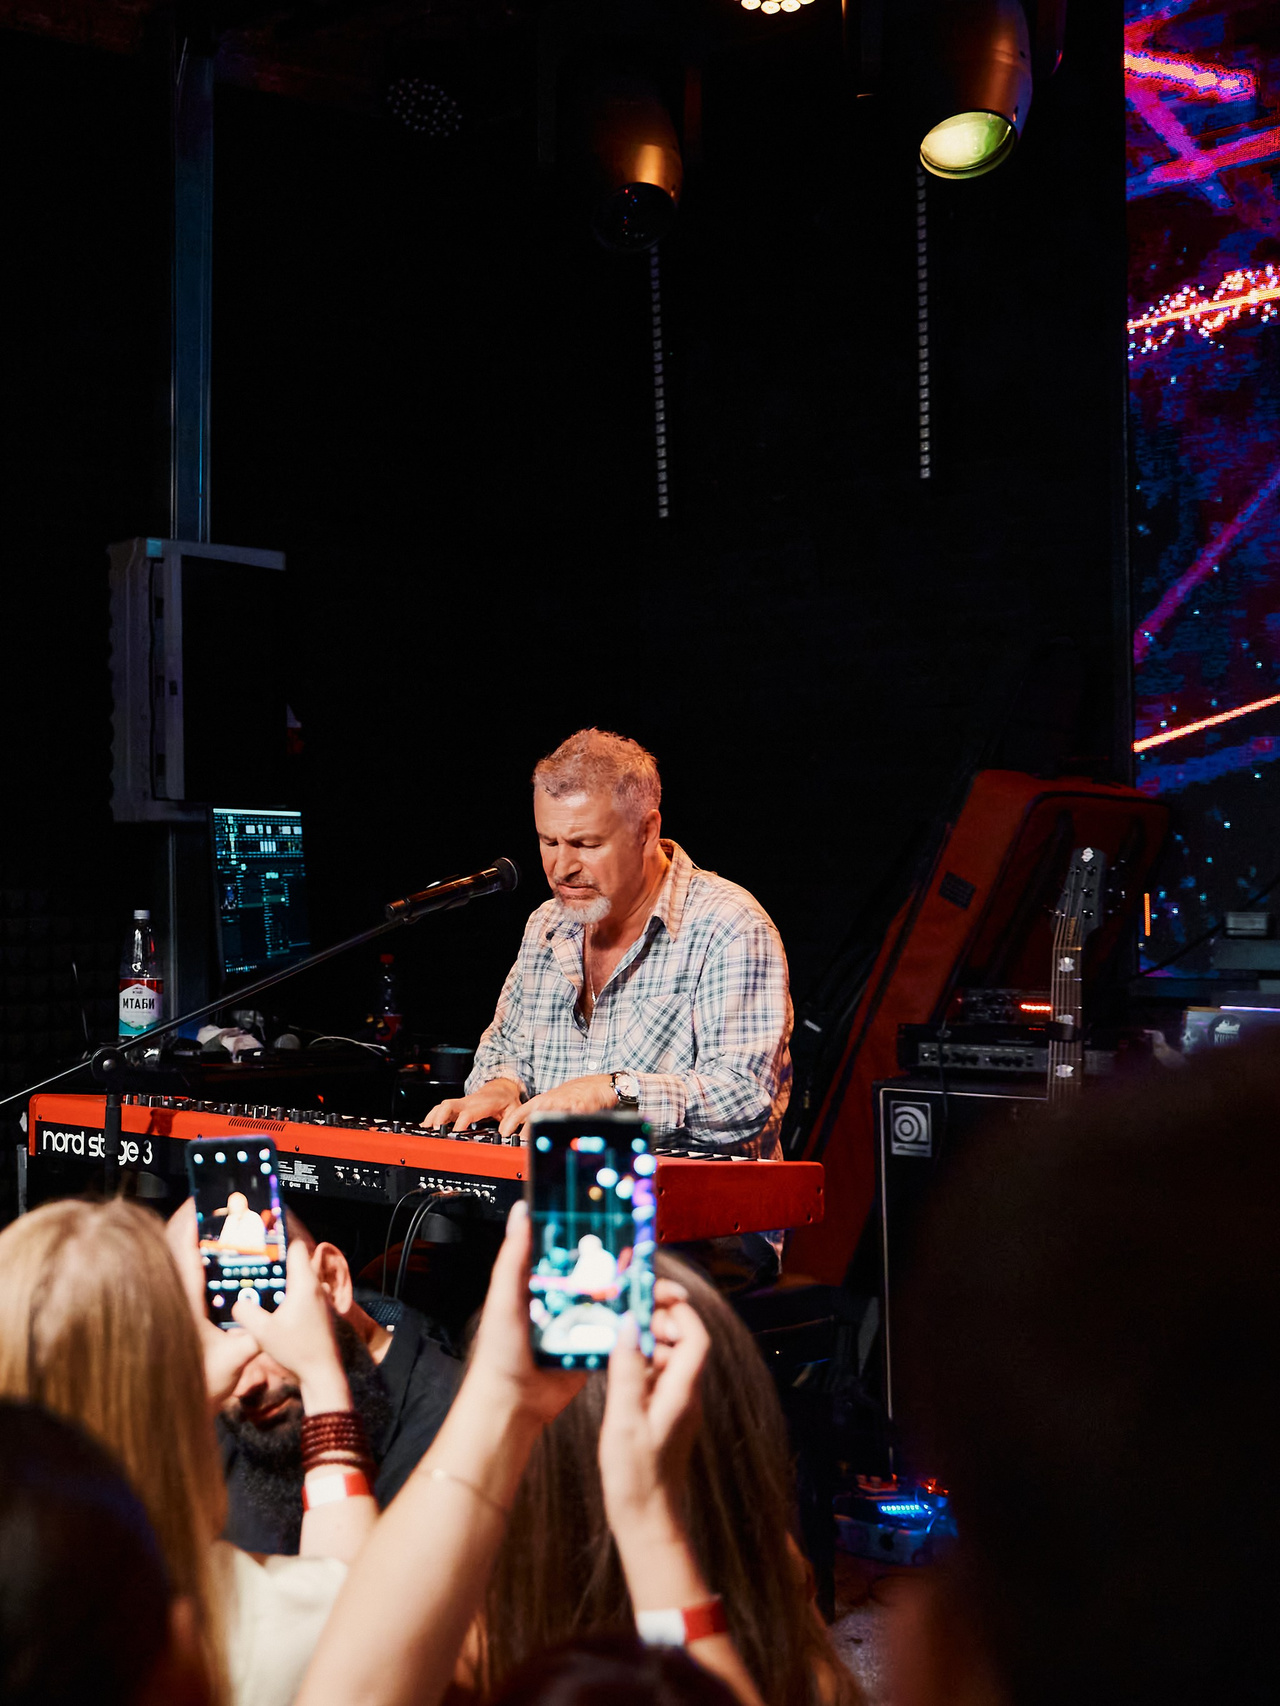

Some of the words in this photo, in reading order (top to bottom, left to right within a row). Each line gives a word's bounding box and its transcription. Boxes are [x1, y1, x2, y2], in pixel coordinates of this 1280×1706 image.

[42, 1130, 85, 1155] nord
[88, 1133, 139, 1166] stge
[142, 1139, 153, 1165] 3
